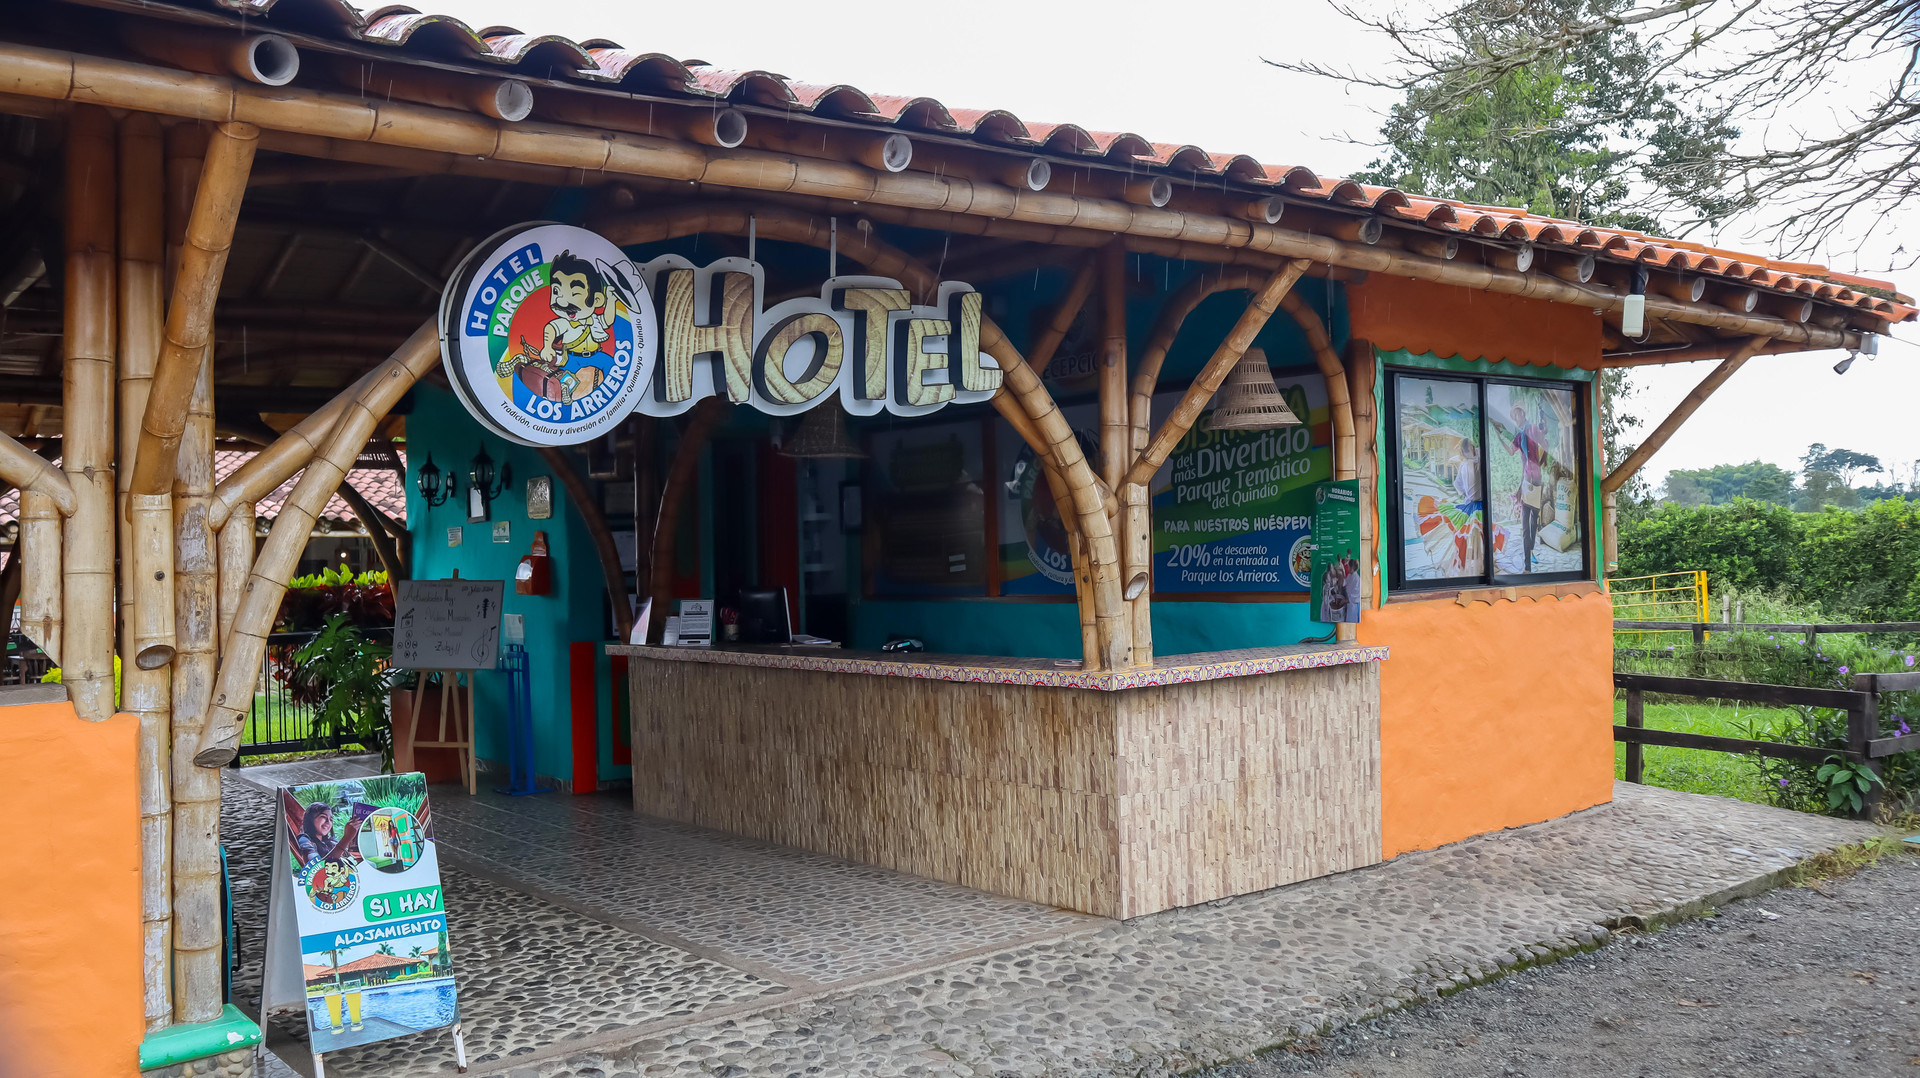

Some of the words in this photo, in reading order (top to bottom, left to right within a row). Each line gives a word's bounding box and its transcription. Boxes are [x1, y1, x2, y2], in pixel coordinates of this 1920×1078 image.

[471, 249, 540, 330] HOTEL
[493, 269, 544, 337] PARQUE
[661, 268, 1004, 406] HOTEL
[525, 394, 563, 421] LOS
[571, 340, 631, 421] ARRIEROS
[501, 400, 531, 428] Tradición,
[532, 424, 558, 435] cultura
[565, 421, 597, 435] diversión
[597, 415, 607, 424] en
[606, 397, 626, 420] familia
[626, 356, 644, 394] Quimbaya
[1177, 453, 1194, 469] del
[1197, 425, 1310, 478] Divertido
[1175, 467, 1197, 483] más
[1177, 477, 1231, 504] Parque
[1235, 457, 1311, 489] Temático
[1212, 494, 1229, 510] del
[1164, 520, 1190, 533] PARA
[1194, 517, 1250, 533] NUESTROS
[1254, 514, 1311, 531] HUÉSPED
[1043, 546, 1067, 570] LOS
[1166, 544, 1211, 567] 20%
[1213, 545, 1223, 555] de
[1225, 545, 1268, 555] descuento
[1213, 557, 1224, 566] en
[1226, 556, 1234, 566] la
[1235, 556, 1269, 566] entrada
[1270, 556, 1279, 566] al
[1181, 570, 1218, 585] Parque
[1219, 570, 1234, 582] los
[1236, 569, 1280, 582] Arrieros.
[1300, 573, 1309, 581] LOS
[299, 856, 321, 885] HOTEL
[306, 863, 323, 886] PARQUE
[320, 901, 334, 910] LOS
[335, 880, 356, 910] ARRIEROS
[369, 896, 392, 918] SI
[400, 888, 440, 914] HAY
[334, 919, 442, 948] ALOJAMIENTO
